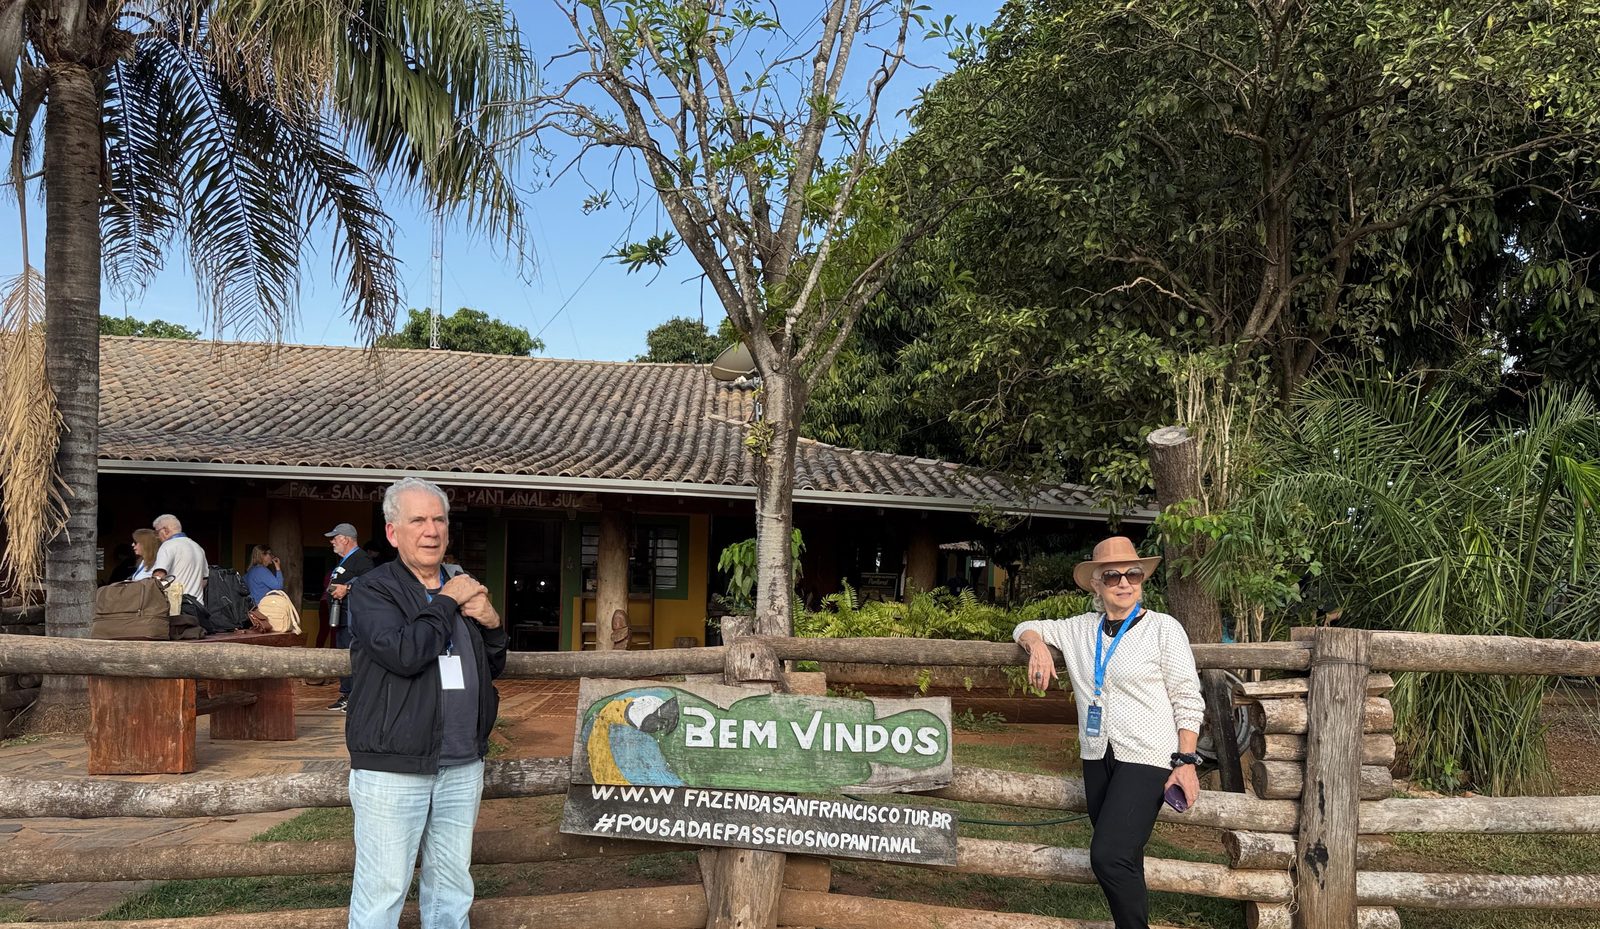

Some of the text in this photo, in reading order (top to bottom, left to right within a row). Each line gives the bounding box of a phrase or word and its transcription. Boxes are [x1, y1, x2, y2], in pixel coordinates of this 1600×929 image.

[331, 484, 364, 500] SAN
[467, 489, 546, 506] PANTANAL
[683, 706, 941, 756] BEM VINDOS
[593, 813, 921, 854] #POUSADAEPASSEIOSNOPANTANAL
